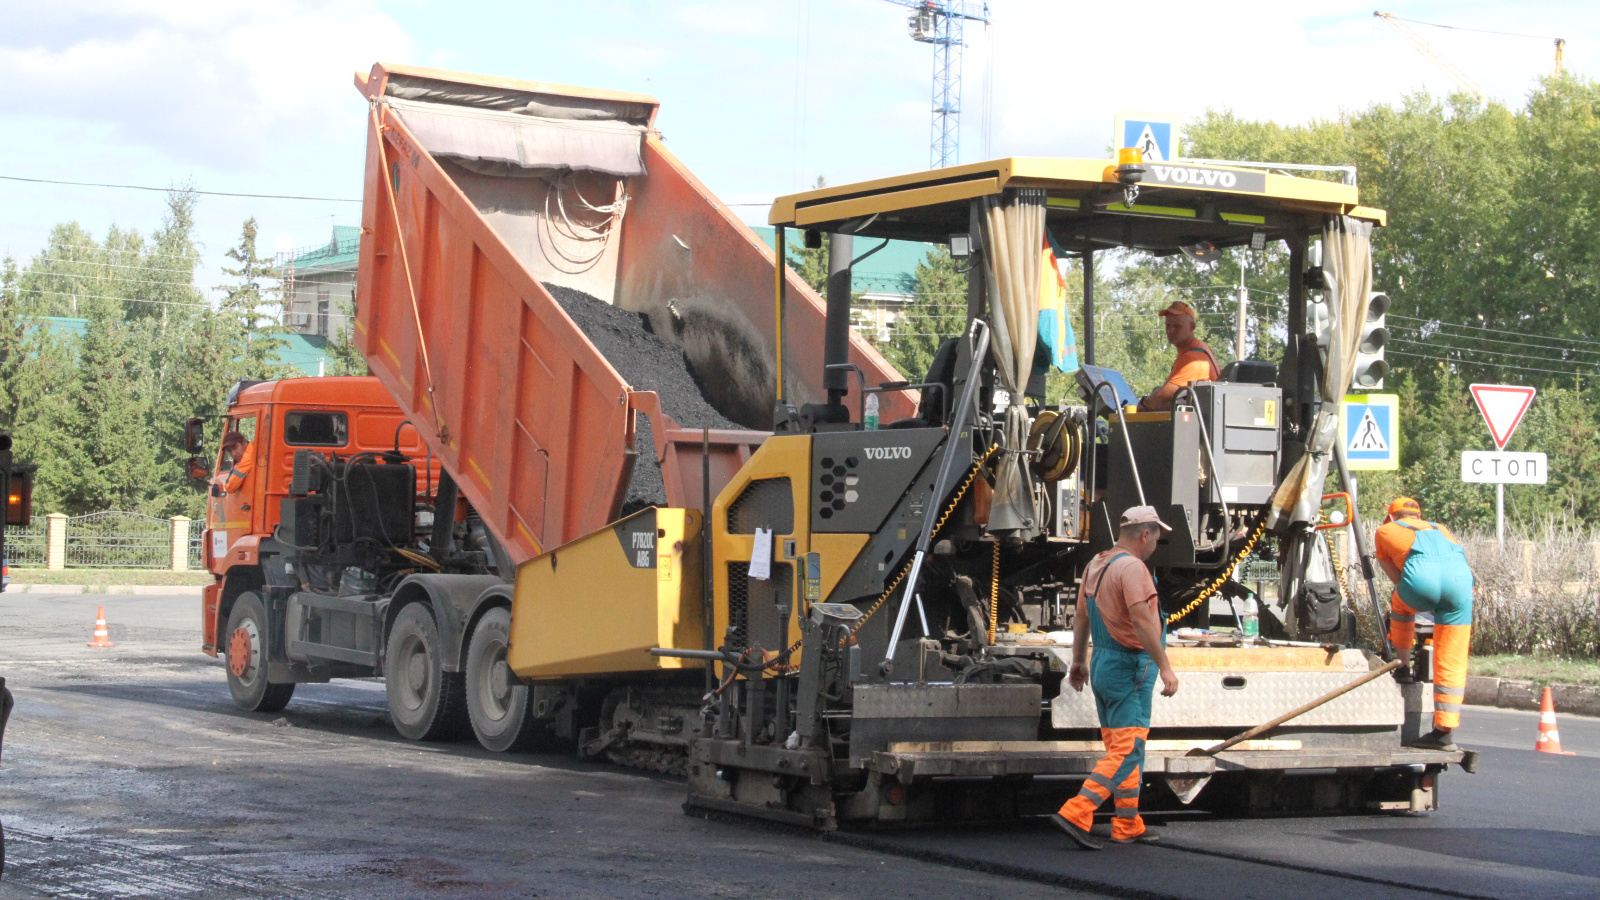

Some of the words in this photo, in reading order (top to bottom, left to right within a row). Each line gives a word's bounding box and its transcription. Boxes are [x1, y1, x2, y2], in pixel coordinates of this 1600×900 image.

[1150, 165, 1237, 188] VOLVO
[863, 446, 912, 460] VOLVO
[1471, 458, 1537, 477] СТОП
[632, 531, 655, 549] P7820C
[636, 550, 650, 567] ABG
